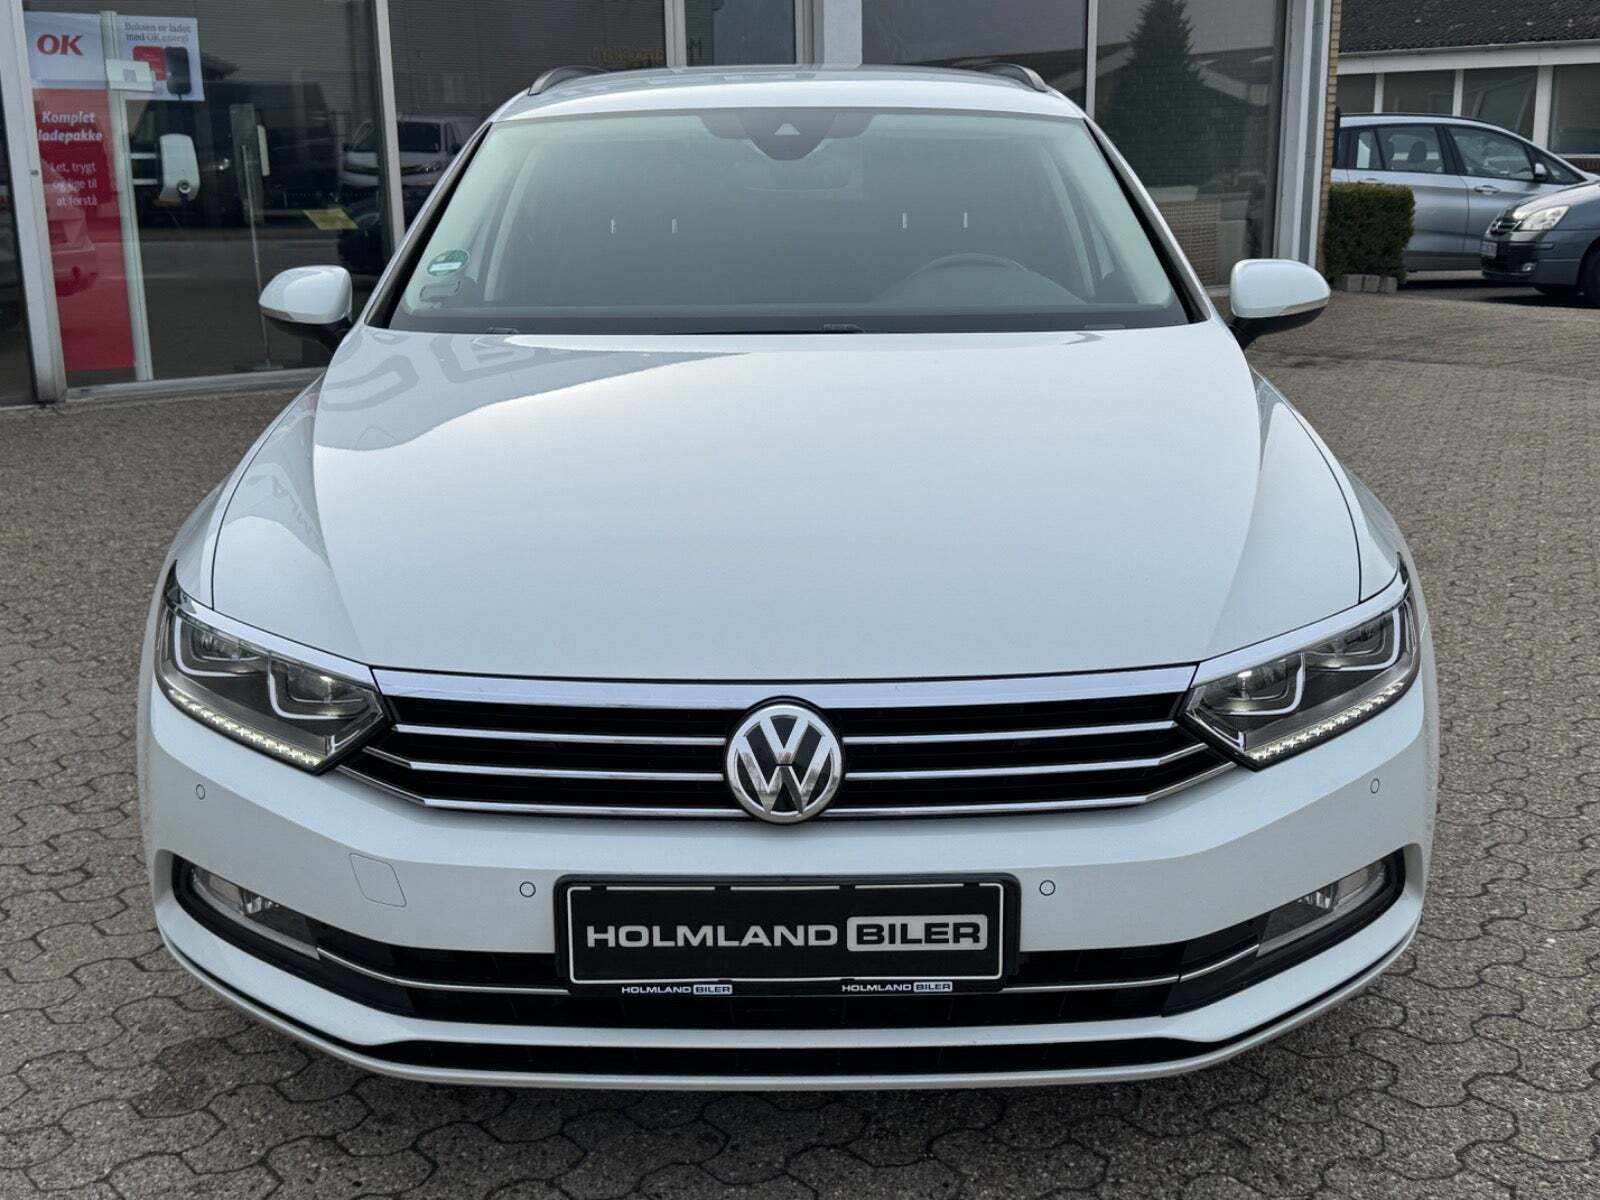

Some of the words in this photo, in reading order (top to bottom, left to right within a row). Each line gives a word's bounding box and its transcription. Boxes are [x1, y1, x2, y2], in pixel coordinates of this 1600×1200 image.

[36, 34, 84, 56] OK
[41, 111, 97, 127] Komplet
[38, 129, 103, 144] ladepakke
[71, 162, 97, 175] trygt
[586, 924, 838, 948] HOLMLAND
[856, 920, 982, 946] BILER
[621, 985, 692, 995] HOLMLAND
[695, 984, 731, 995] BILER
[841, 982, 912, 993] HOLMLAND
[915, 981, 951, 992] BILER
